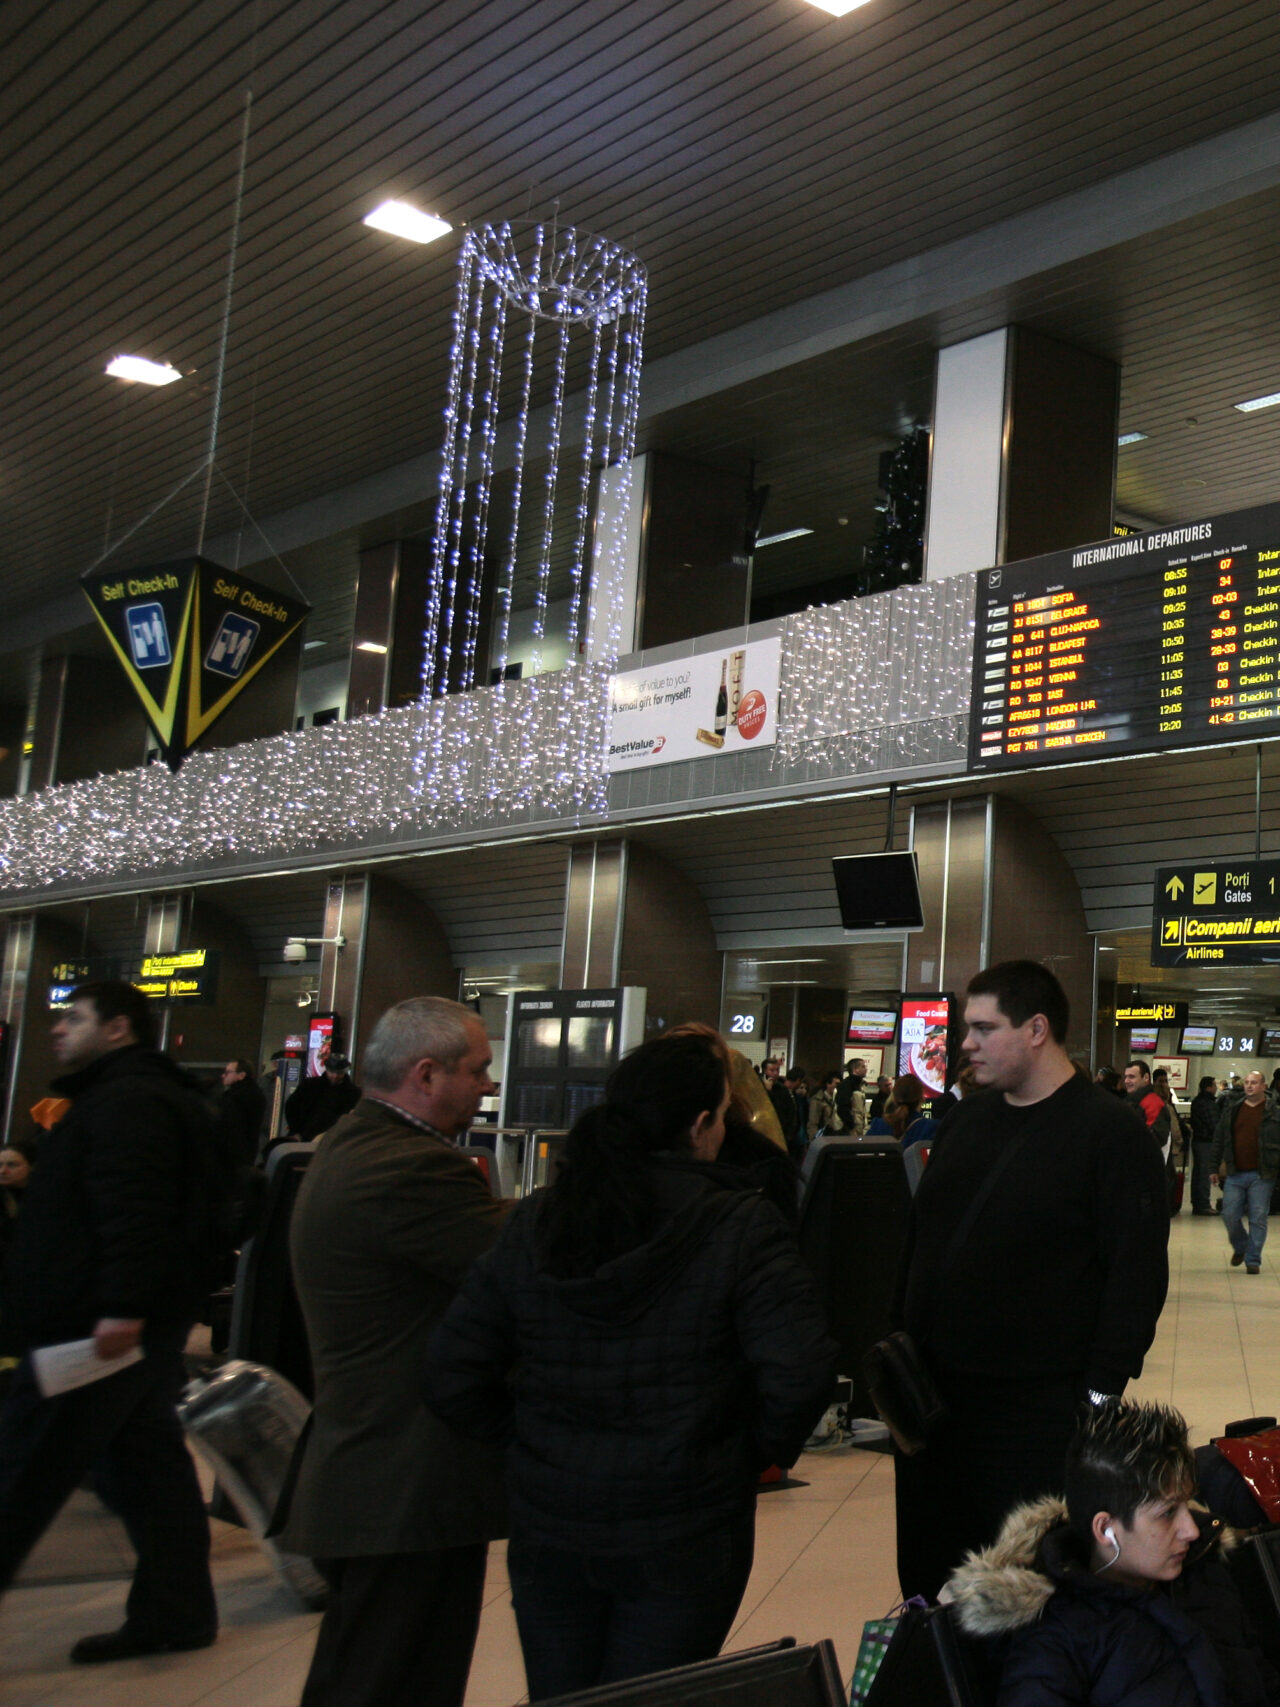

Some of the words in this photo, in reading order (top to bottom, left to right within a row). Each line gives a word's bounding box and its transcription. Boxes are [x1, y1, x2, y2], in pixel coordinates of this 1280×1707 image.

[1073, 537, 1144, 568] INTERNATIONAL
[1148, 523, 1212, 550] DEPARTURES
[1165, 568, 1187, 581] 08:55
[1220, 559, 1231, 569] 07
[102, 584, 123, 600] Self
[128, 574, 179, 595] Check-In
[1164, 585, 1186, 597] 09:10
[213, 579, 239, 601] Self
[240, 591, 288, 623] Check-In
[1163, 602, 1185, 614] 09:25
[1163, 619, 1184, 630] 10:35
[1163, 636, 1184, 647] 10:50
[1162, 652, 1183, 663] 11:05
[1162, 669, 1183, 680] 11:35
[1161, 685, 1183, 698] 11:45
[639, 695, 652, 711] gift
[653, 692, 663, 704] for
[752, 704, 765, 717] FREE
[1161, 703, 1182, 714] 12:05
[1160, 720, 1181, 731] 12:20
[1269, 877, 1274, 895] 1
[1224, 890, 1251, 903] Gates
[1186, 918, 1252, 938] Companii
[1186, 947, 1224, 960] Airlines
[731, 1015, 755, 1033] 28
[904, 1028, 922, 1037] ASIA
[1219, 1037, 1234, 1051] 33
[1240, 1038, 1254, 1052] 34
